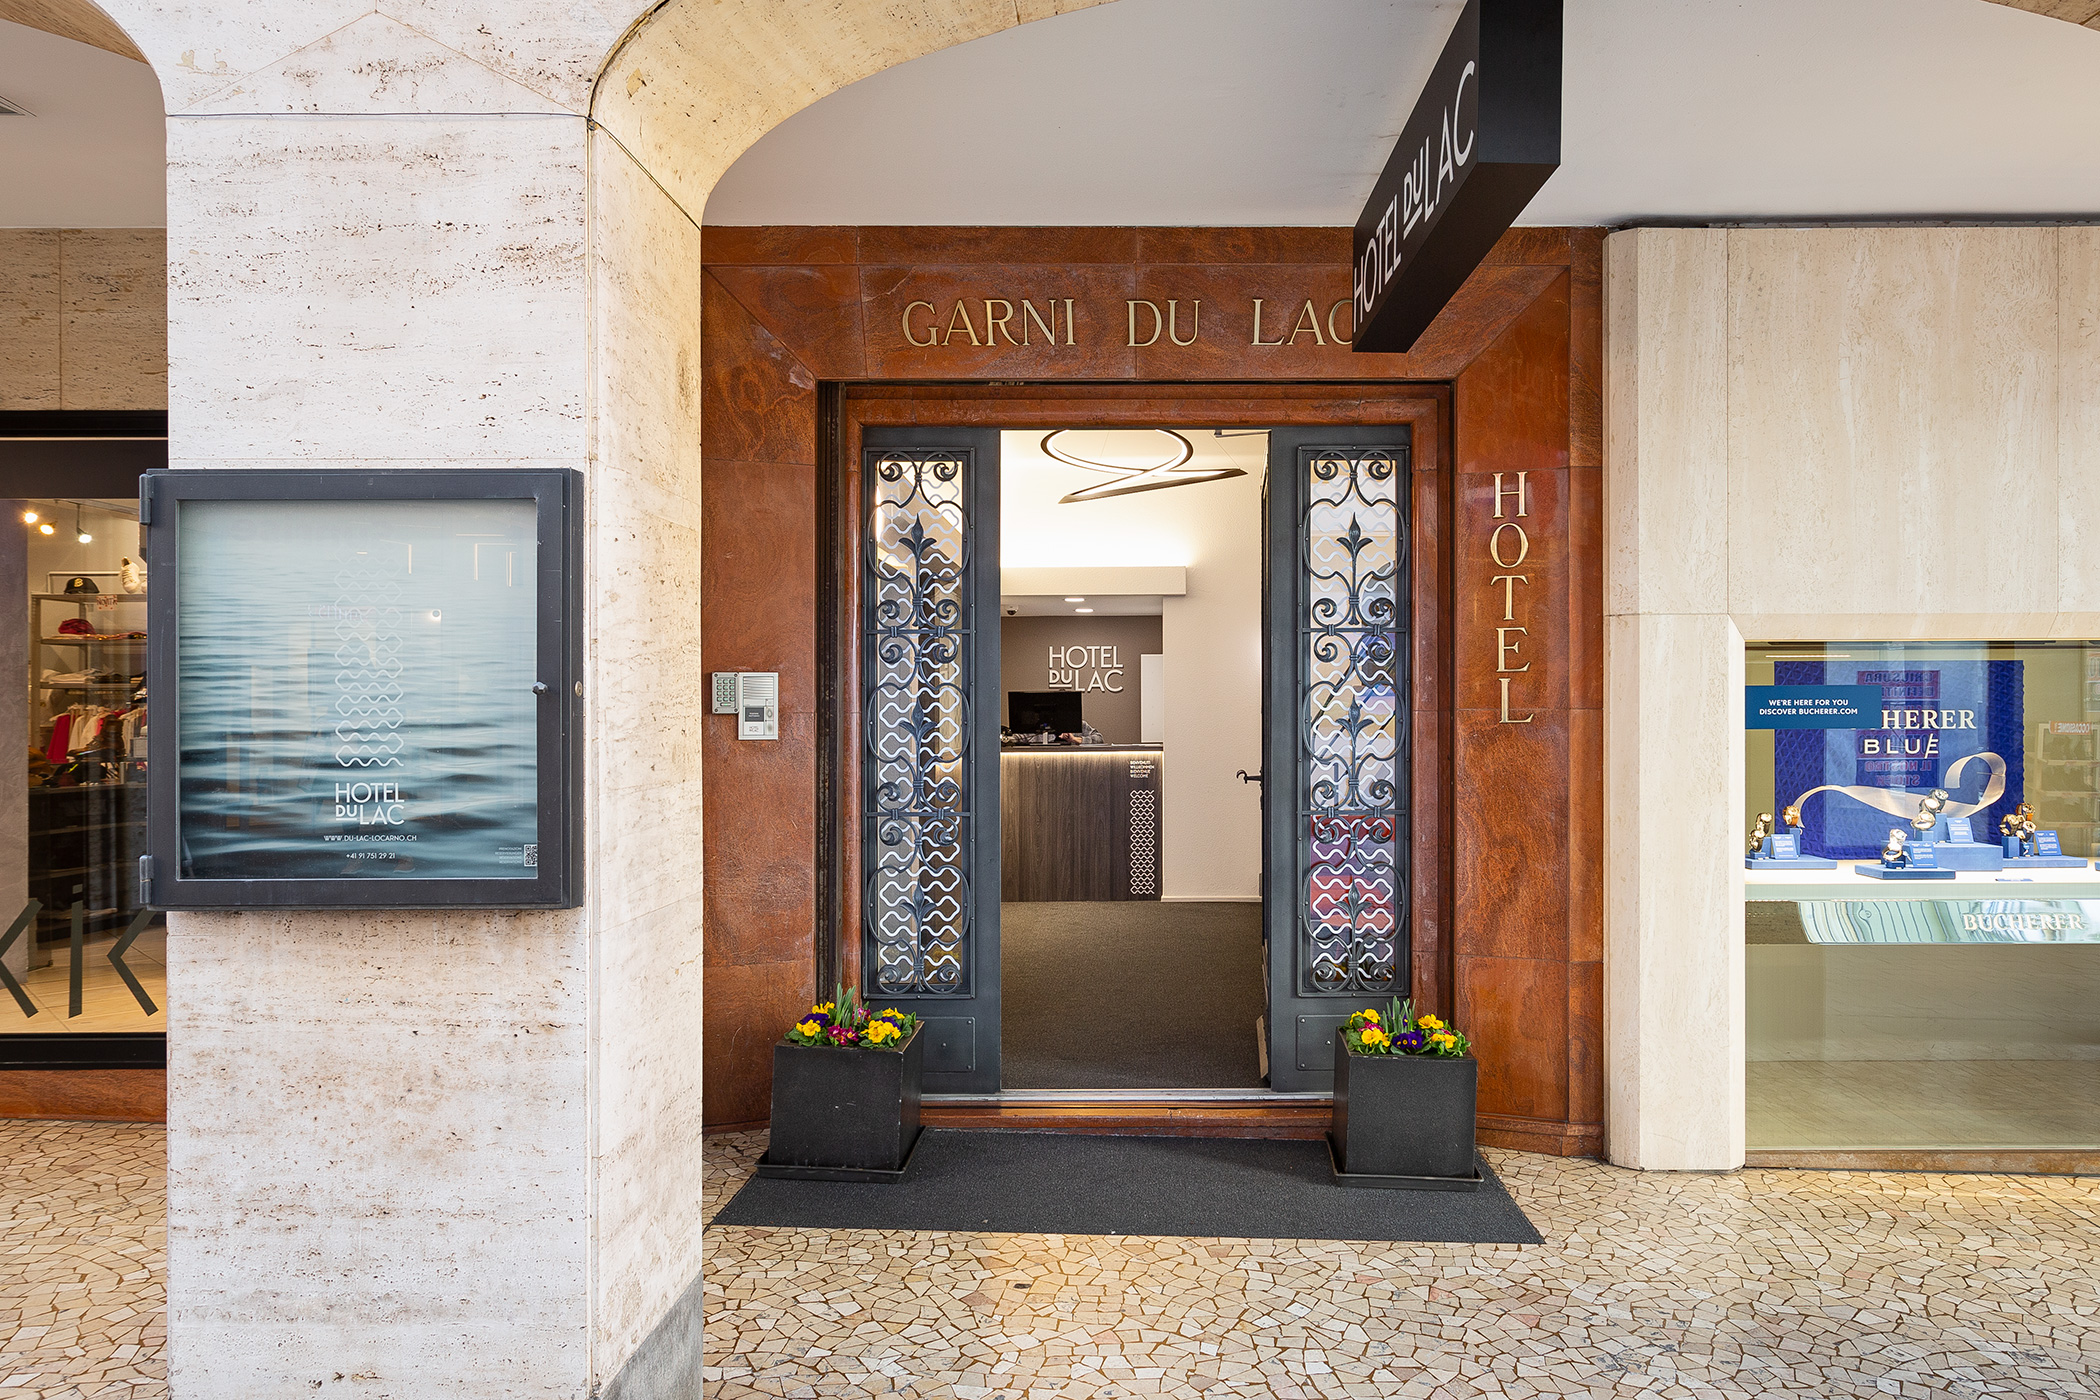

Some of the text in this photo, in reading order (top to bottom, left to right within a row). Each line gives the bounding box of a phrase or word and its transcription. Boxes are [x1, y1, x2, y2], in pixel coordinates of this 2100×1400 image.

[1353, 60, 1475, 333] HOTEL DU LAC
[902, 298, 1353, 347] GARNI DU LAC
[1490, 471, 1534, 724] HOTEL
[1048, 645, 1124, 669] HOTEL
[1048, 669, 1124, 692] DU LAC
[1863, 733, 1939, 759] BLUE
[335, 782, 405, 803] HOTEL
[335, 804, 405, 825] DU LAC
[1963, 913, 2087, 931] BUCHERER
